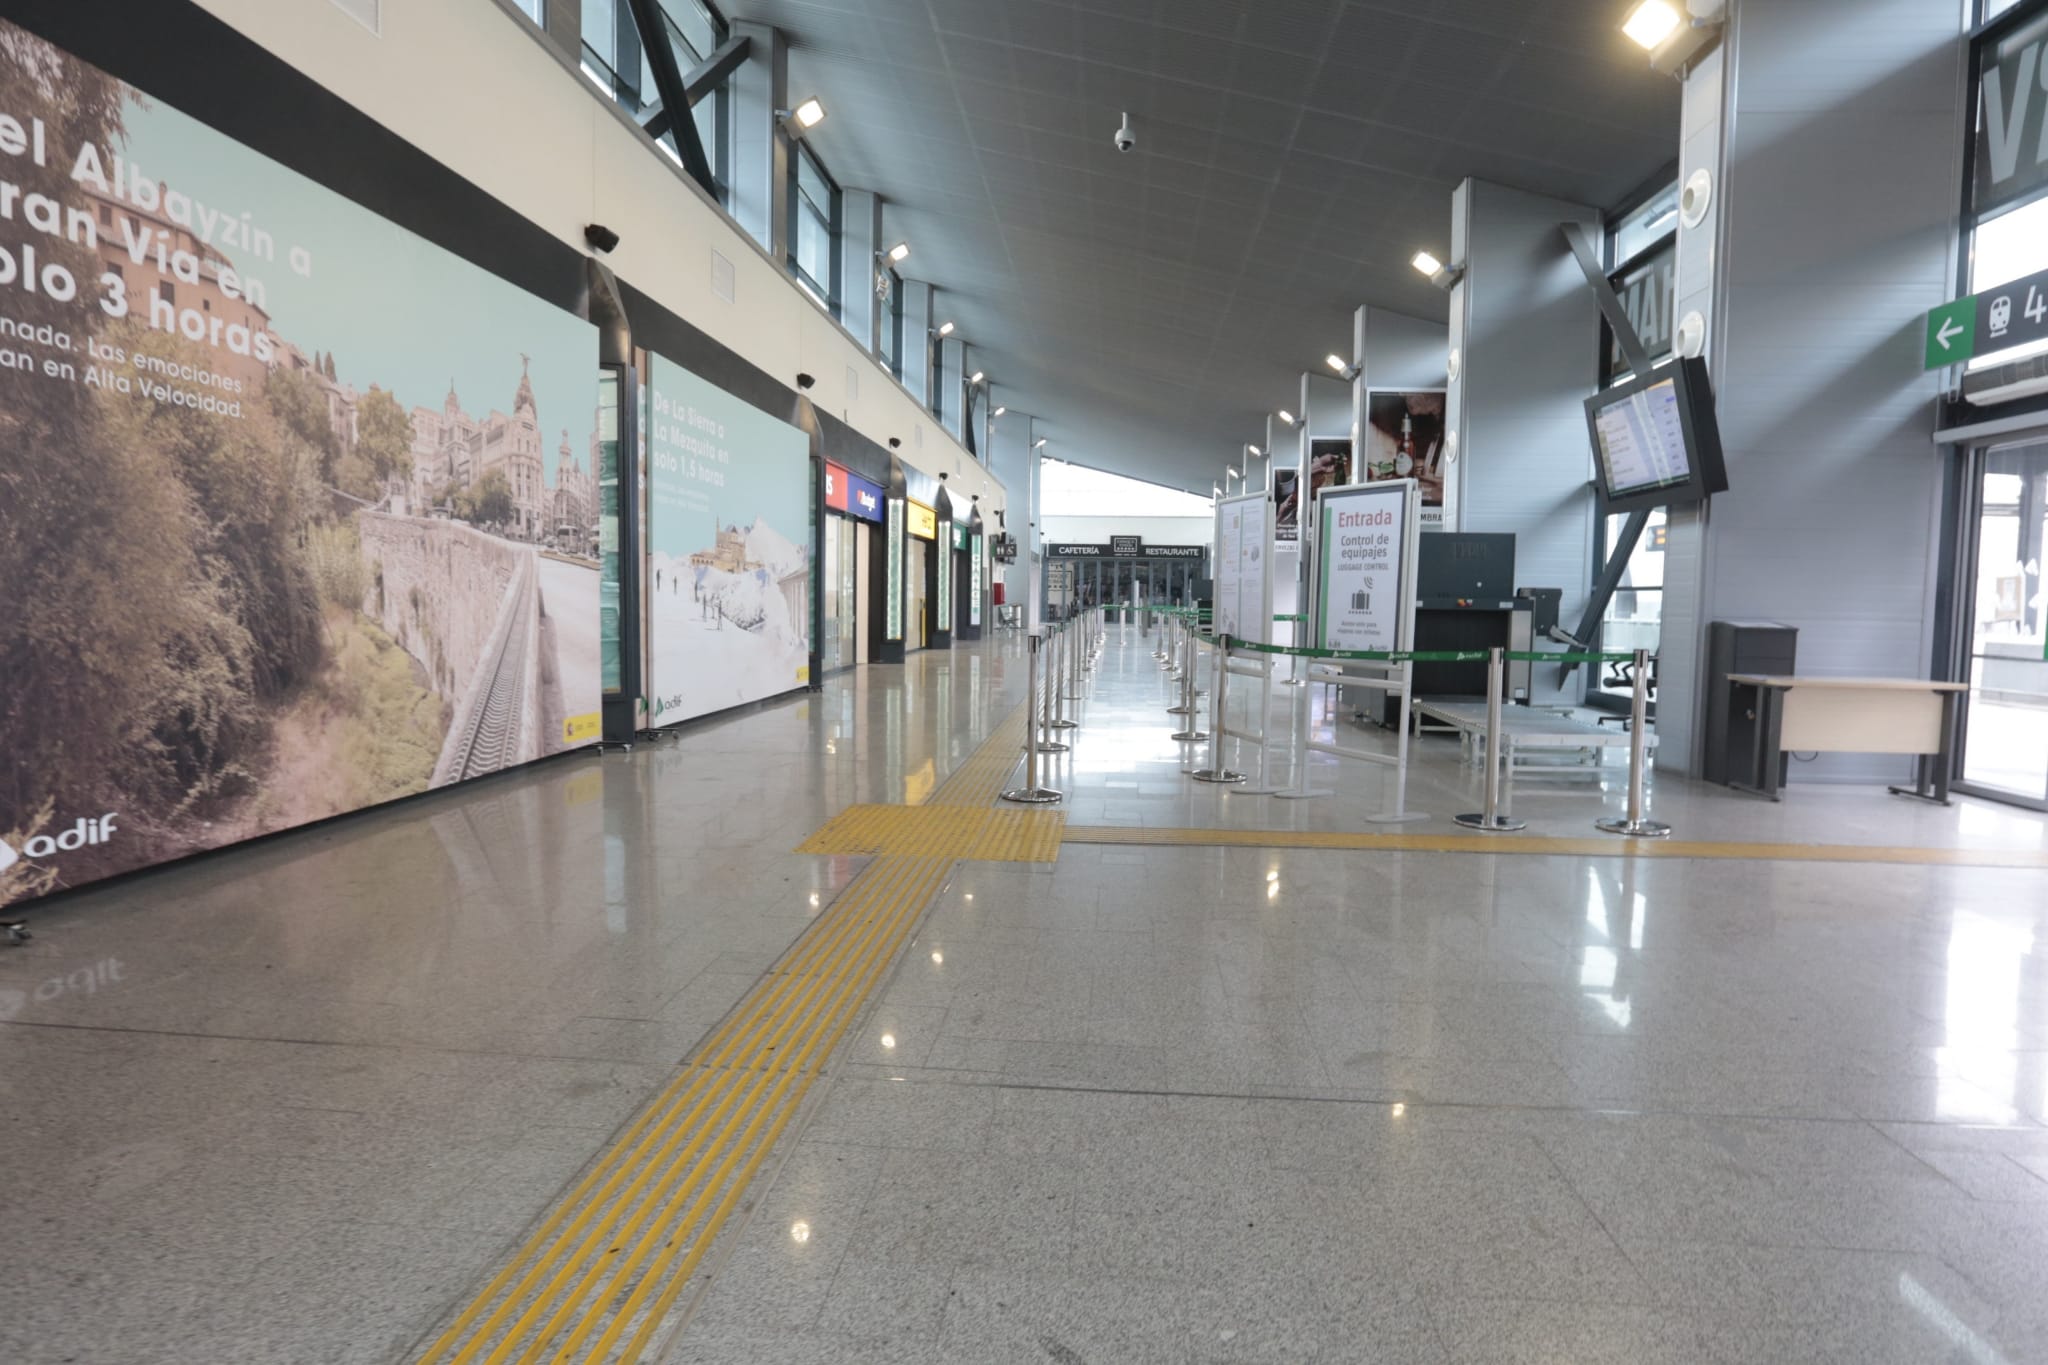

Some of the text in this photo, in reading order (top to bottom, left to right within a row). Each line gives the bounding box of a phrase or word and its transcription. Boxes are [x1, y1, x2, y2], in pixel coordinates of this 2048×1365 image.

[70, 141, 274, 262] Albayzín
[289, 244, 312, 278] a
[119, 217, 200, 286] Vía
[218, 263, 266, 308] en
[100, 272, 129, 318] 3
[150, 287, 275, 363] horas
[2023, 284, 2048, 324] 4
[88, 335, 126, 364] Las
[133, 351, 242, 393] emociones
[44, 360, 75, 381] en
[84, 368, 131, 393] Alta
[139, 377, 247, 418] Velocidad.
[654, 391, 725, 439] De La Sierra a
[654, 420, 729, 464] La Mezquita en
[654, 451, 677, 472] solo
[681, 455, 697, 480] 1,5
[699, 463, 725, 487] horas
[1338, 508, 1393, 528] Entrada
[1058, 545, 1100, 555] CAFETERÍA
[1145, 547, 1199, 556] RESTAURANTE
[1340, 534, 1389, 546] Control de
[1341, 546, 1388, 560] equipajes
[664, 694, 682, 710] adif
[23, 812, 119, 858] adif
